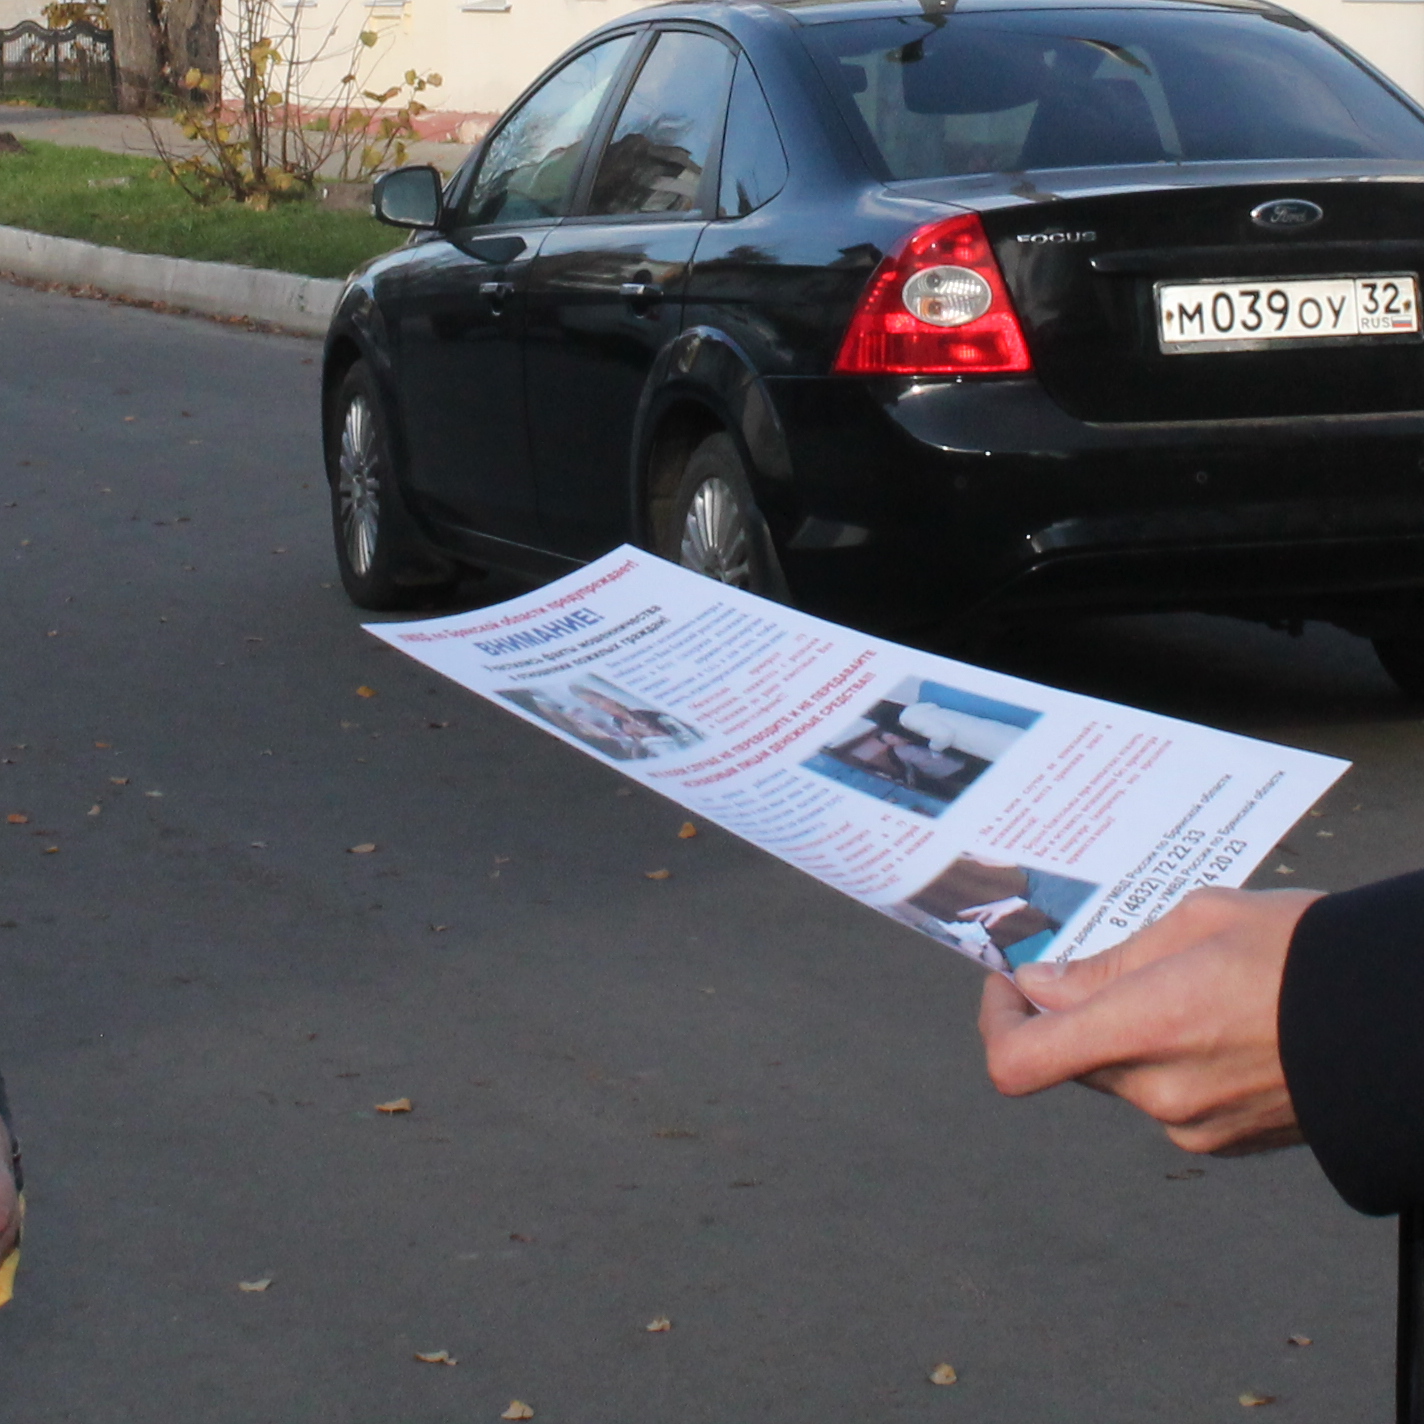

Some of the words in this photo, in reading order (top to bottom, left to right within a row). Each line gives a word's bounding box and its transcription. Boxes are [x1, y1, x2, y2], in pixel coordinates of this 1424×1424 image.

[1016, 232, 1096, 244] FOCUS
[1362, 282, 1402, 316] 32
[1361, 316, 1390, 330] RUS
[474, 607, 606, 657] ВНИМАНИЕ!
[810, 648, 878, 703] ПЕРЕДАВАЙТЕ
[1253, 769, 1287, 802] области
[1216, 799, 1258, 838] Брянской
[1104, 874, 1136, 906] УМВД
[1127, 849, 1159, 880] России
[1154, 838, 1170, 852] по
[1162, 802, 1204, 842] Брянской
[1200, 772, 1233, 805] области
[1209, 834, 1225, 849] по
[1209, 854, 1235, 873] 20
[1224, 838, 1249, 857] 23
[1108, 915, 1129, 929] 8
[1122, 875, 1167, 918] (4832)
[1152, 852, 1178, 878] 72
[1167, 842, 1193, 863] 22
[1181, 828, 1207, 846] 33
[1180, 846, 1212, 878] России
[1157, 877, 1188, 904] УМВД
